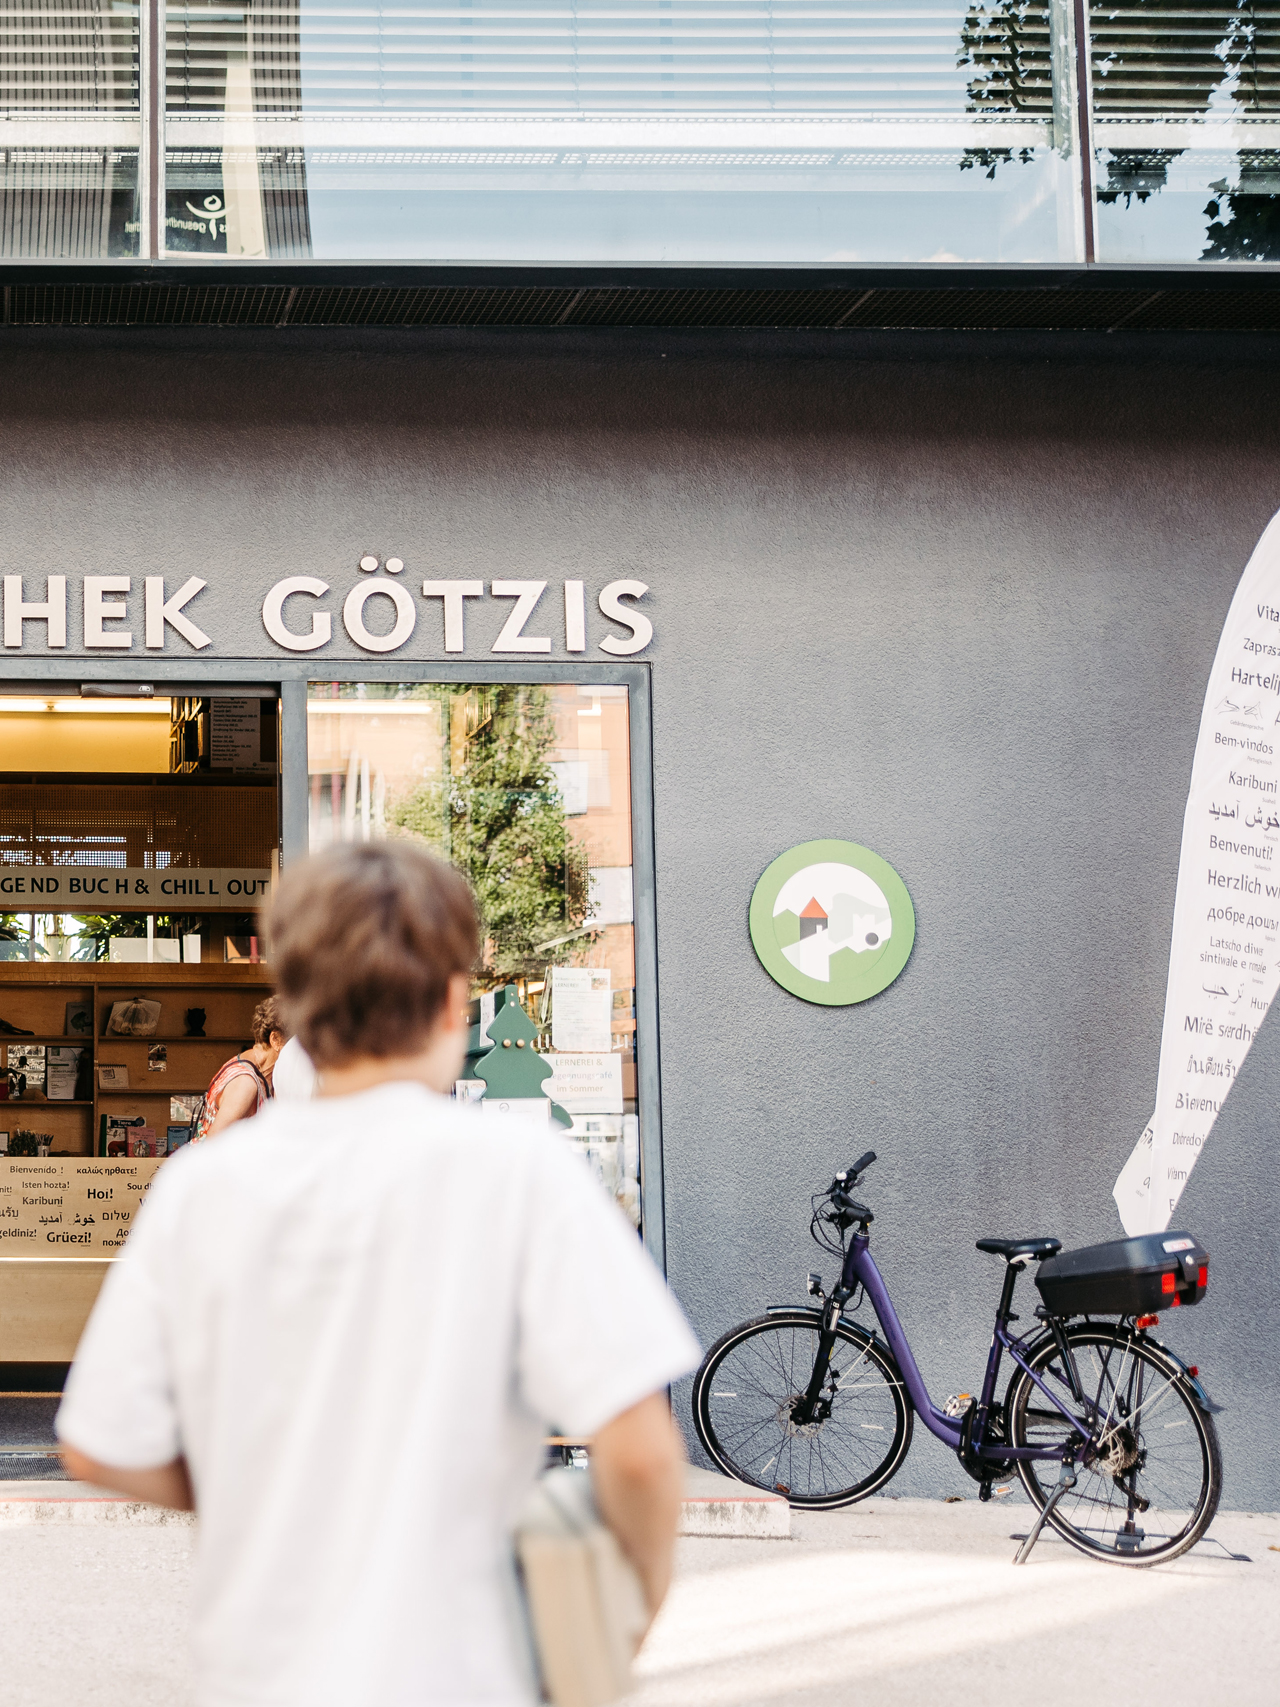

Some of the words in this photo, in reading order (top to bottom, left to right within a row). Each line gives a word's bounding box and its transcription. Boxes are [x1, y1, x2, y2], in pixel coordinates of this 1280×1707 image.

[262, 556, 653, 656] GÖTZIS
[1214, 732, 1274, 755] Bem-vindos
[1228, 770, 1278, 794] Karibuni
[1209, 834, 1274, 861] Benvenuti!
[69, 878, 129, 894] BUCH
[134, 879, 150, 894] &
[161, 879, 219, 895] CHILL
[227, 879, 269, 895] OUT
[1207, 868, 1261, 895] Herzlich
[1206, 906, 1245, 926] добре
[1209, 935, 1242, 953] Latscho
[1240, 960, 1247, 969] e
[22, 1181, 42, 1189] Isten
[44, 1181, 70, 1189] hozta!
[87, 1188, 113, 1199] Hoi!
[22, 1196, 63, 1205] Karibuni
[102, 1210, 130, 1221] שלום
[46, 1232, 91, 1243] Grüezi!
